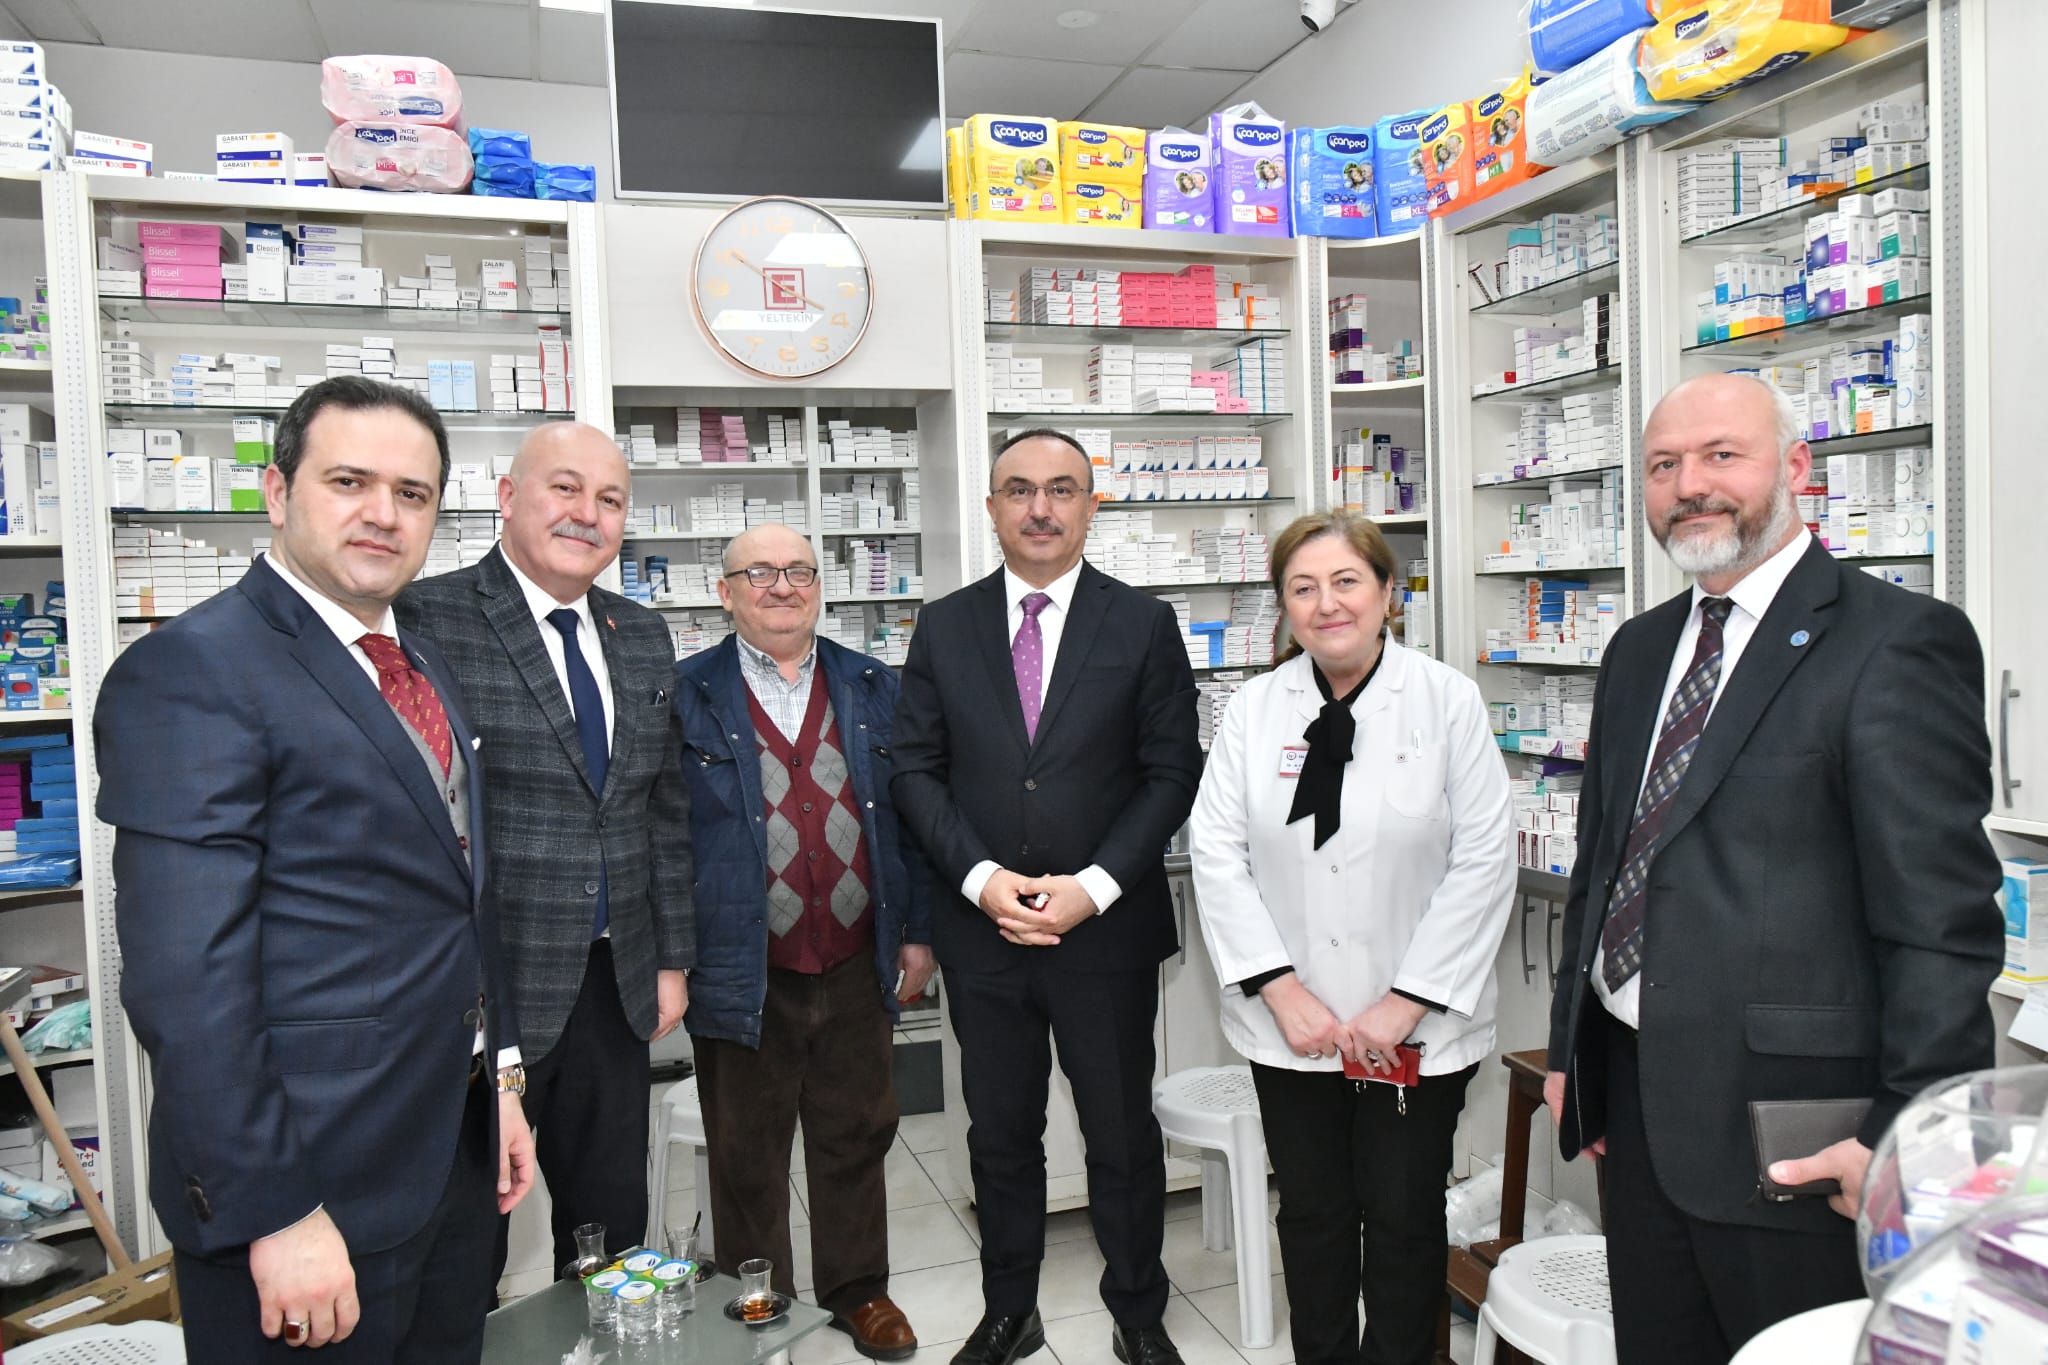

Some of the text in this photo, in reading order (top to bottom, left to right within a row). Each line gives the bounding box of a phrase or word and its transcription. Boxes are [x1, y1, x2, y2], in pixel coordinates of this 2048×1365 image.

[357, 129, 396, 143] canped
[993, 123, 1045, 142] canped
[1080, 131, 1106, 142] canped
[1236, 126, 1280, 142] canped
[1328, 133, 1367, 149] canped
[1162, 145, 1199, 159] canped
[72, 158, 103, 167] GABASET
[143, 226, 172, 237] Blissel
[148, 246, 178, 257] Blissel
[151, 266, 180, 277] Blissel
[708, 279, 730, 297] 9
[758, 311, 814, 323] YELTEKİN
[830, 312, 849, 328] 4
[745, 337, 765, 353] 7
[809, 336, 830, 353] 5
[778, 346, 799, 363] 6
